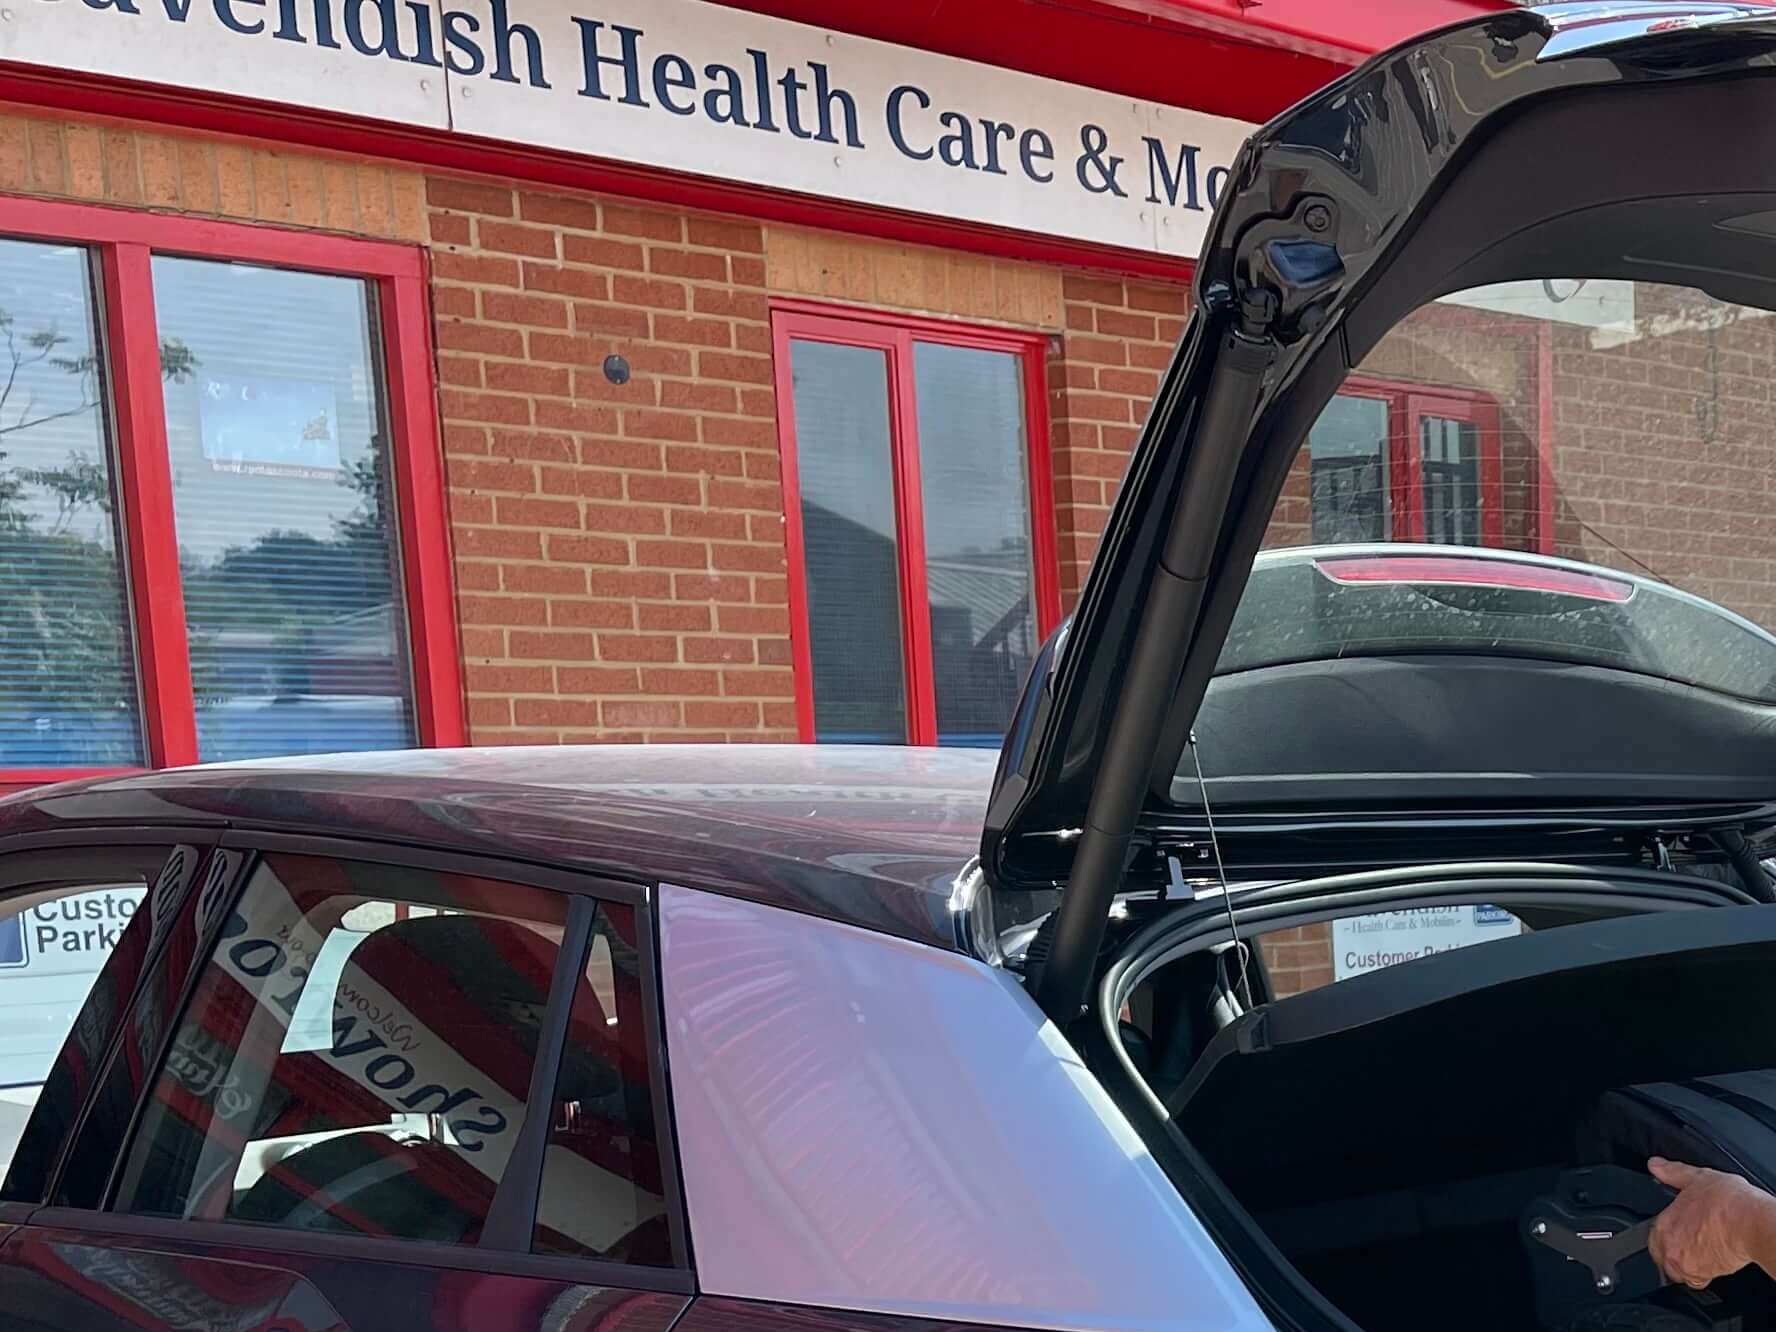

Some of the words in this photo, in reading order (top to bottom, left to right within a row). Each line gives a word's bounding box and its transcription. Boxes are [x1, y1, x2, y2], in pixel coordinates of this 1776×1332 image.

[570, 16, 865, 148] Health
[886, 85, 1054, 183] Care
[1076, 123, 1128, 198] &
[33, 893, 137, 922] Custo
